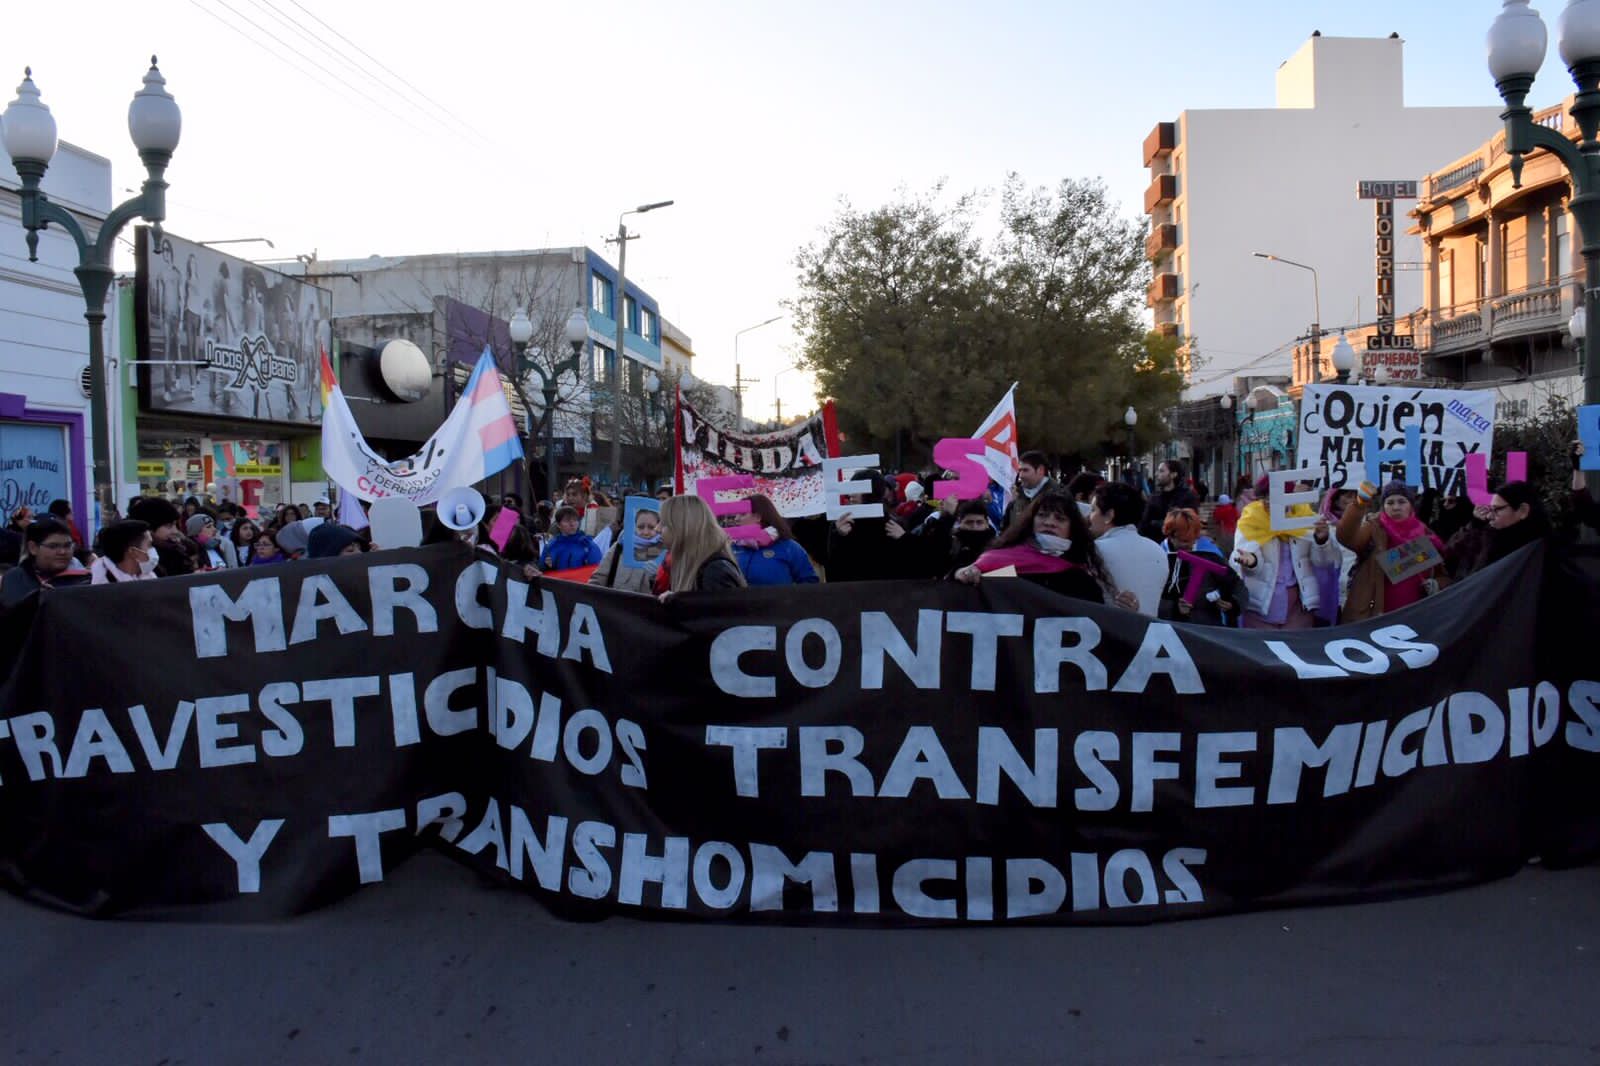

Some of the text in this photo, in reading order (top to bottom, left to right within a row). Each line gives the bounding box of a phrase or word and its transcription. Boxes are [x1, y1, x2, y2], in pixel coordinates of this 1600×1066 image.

[1360, 181, 1416, 197] HOTEL
[1377, 200, 1393, 334] TOURING
[267, 354, 296, 381] Jeans
[1363, 351, 1419, 367] COCHERAS
[1369, 336, 1414, 348] CLUB
[1304, 389, 1445, 436] ¿Quién
[933, 437, 990, 500] S
[1363, 424, 1420, 486] H
[0, 478, 50, 511] Dulce
[822, 453, 885, 521] E
[1269, 467, 1323, 531] E
[188, 561, 1440, 698] MARCHA CONTRA LOS
[705, 679, 1600, 812] TRANSFEMICIDIOS
[200, 791, 1207, 921] Y TRANSHOMICIDIOS
